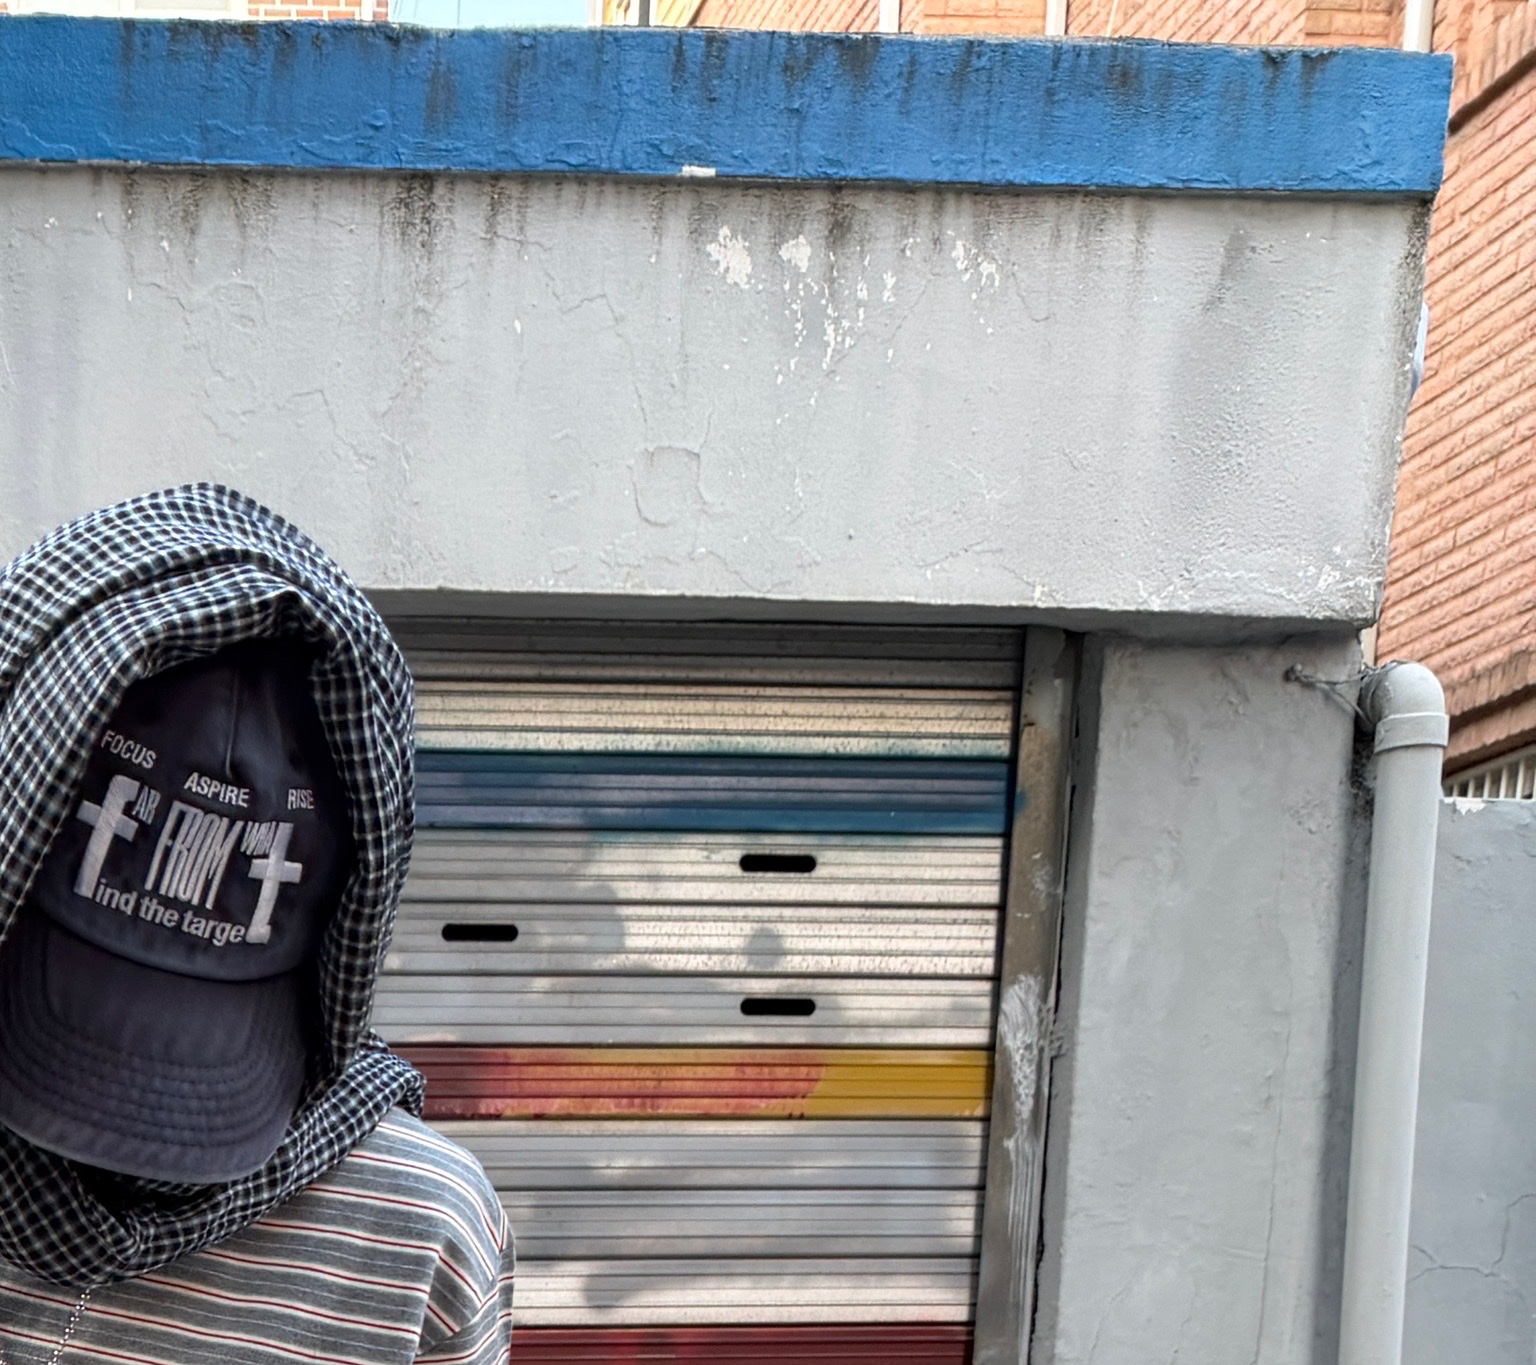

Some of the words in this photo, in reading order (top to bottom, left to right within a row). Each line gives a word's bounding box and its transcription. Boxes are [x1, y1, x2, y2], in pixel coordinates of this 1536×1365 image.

[100, 729, 157, 769] FOCUS
[183, 771, 250, 808] ASPIRE
[287, 788, 315, 810] RISE
[144, 800, 245, 910] FROM
[138, 896, 180, 928] the
